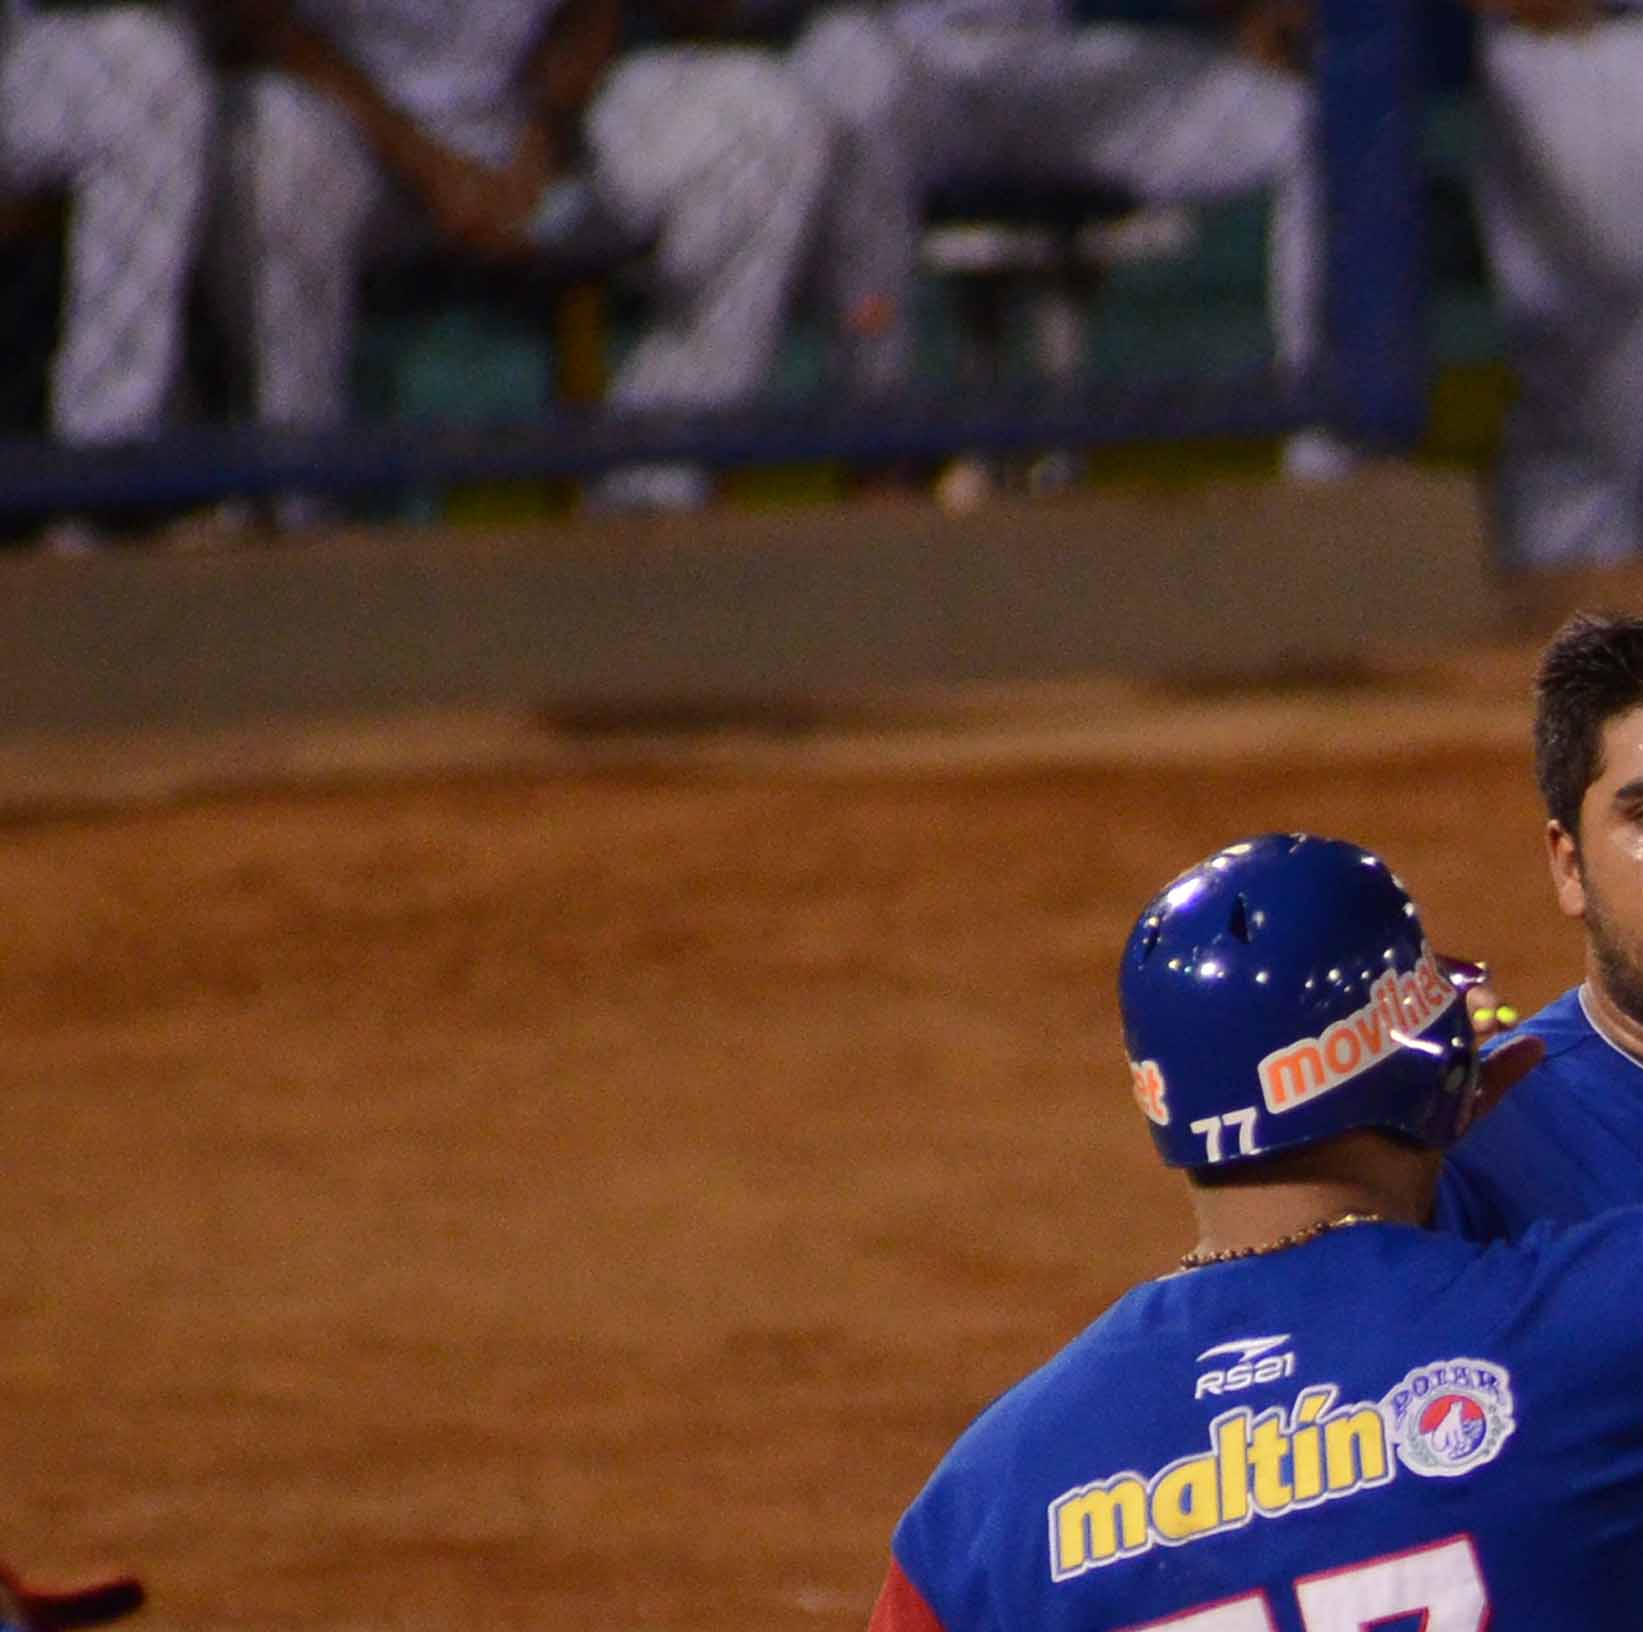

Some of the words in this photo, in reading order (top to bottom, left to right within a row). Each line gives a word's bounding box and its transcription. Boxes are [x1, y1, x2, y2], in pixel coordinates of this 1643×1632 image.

[1189, 1107, 1262, 1162] 77
[1195, 1352, 1297, 1399] RS21
[1050, 1386, 1393, 1580] maltín
